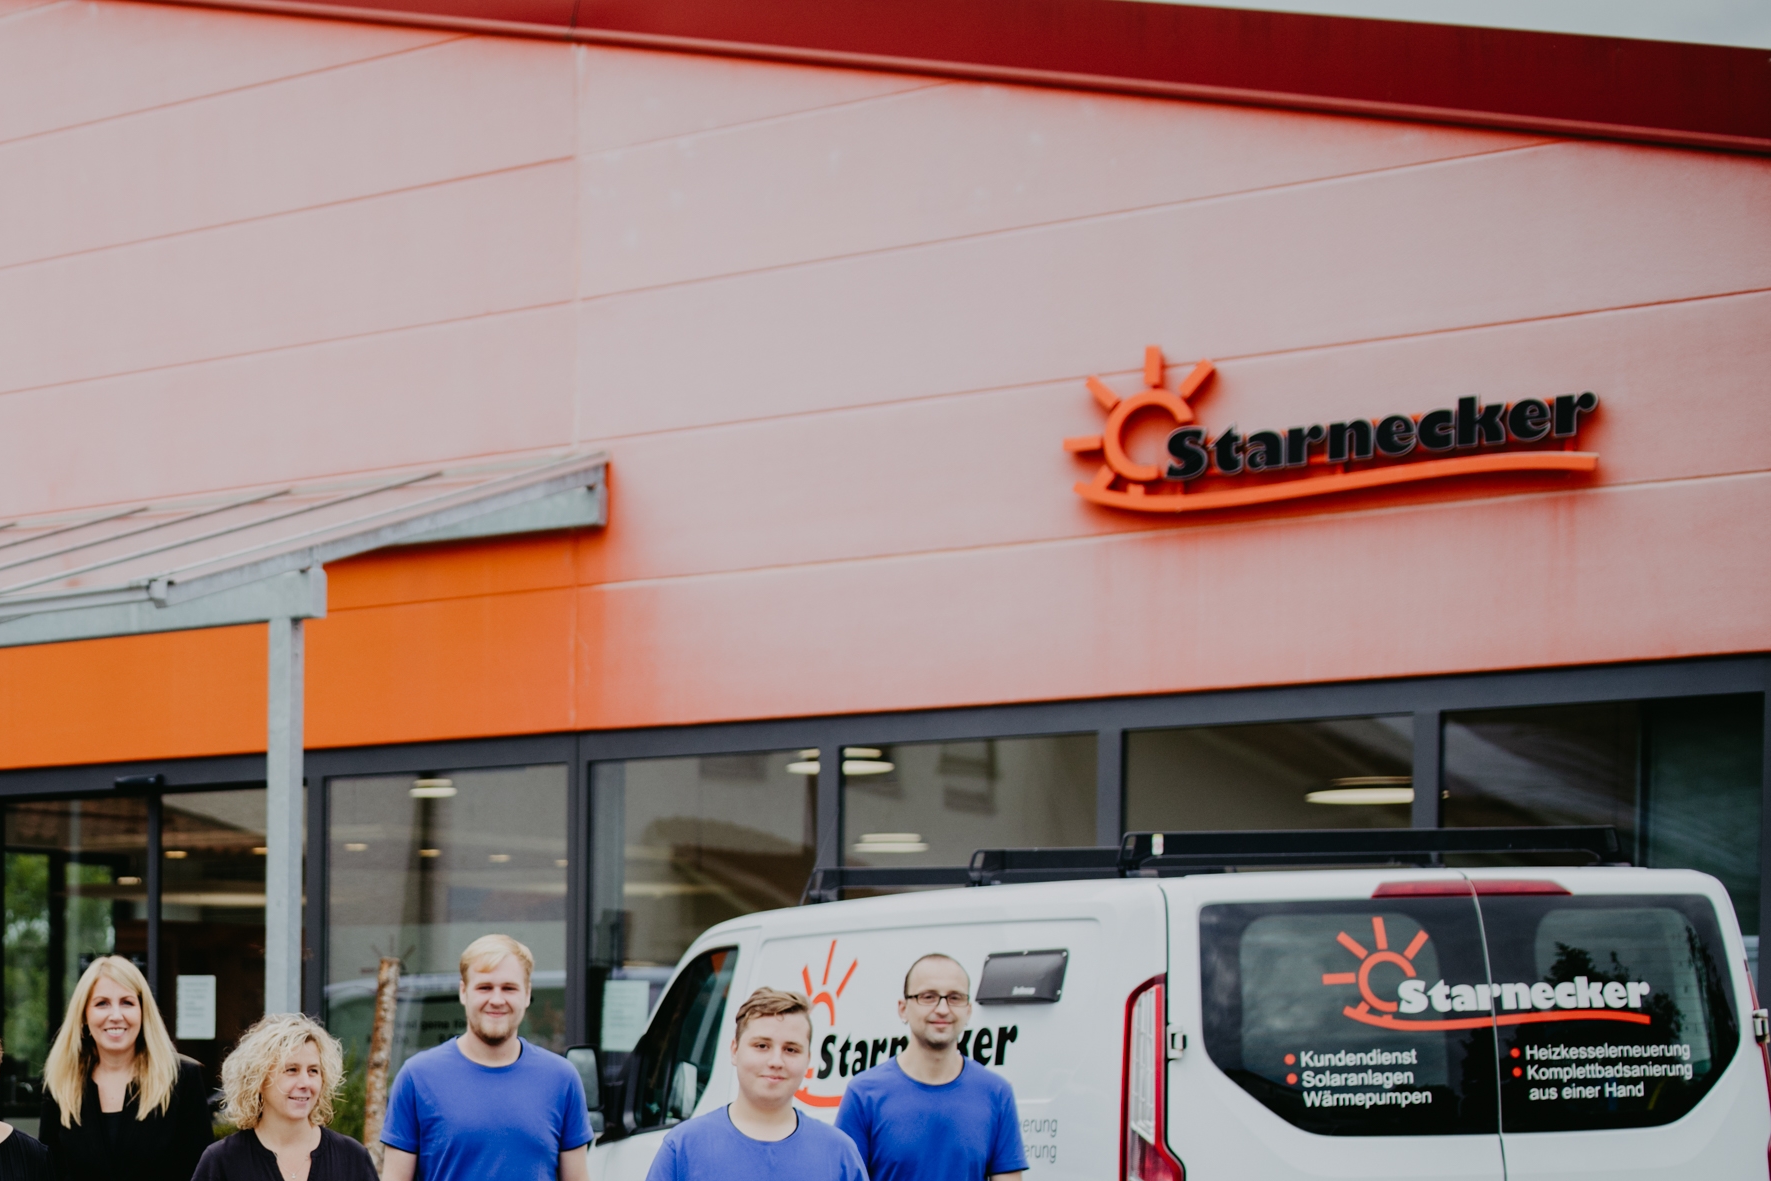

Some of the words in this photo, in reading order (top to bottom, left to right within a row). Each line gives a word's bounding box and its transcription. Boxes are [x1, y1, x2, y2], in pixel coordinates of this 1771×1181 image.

[1166, 391, 1599, 480] Starnecker
[1397, 976, 1651, 1014] Starnecker
[1300, 1048, 1418, 1068] Kundendienst
[1525, 1042, 1691, 1061] Heizkesselerneuerung
[1302, 1069, 1415, 1089] Solaranlagen
[1526, 1061, 1693, 1082] Komplettbadsanierung
[1303, 1090, 1433, 1110] Wärmepumpen
[1529, 1087, 1559, 1101] aus
[1561, 1083, 1601, 1099] einer
[1604, 1081, 1645, 1098] Hand
